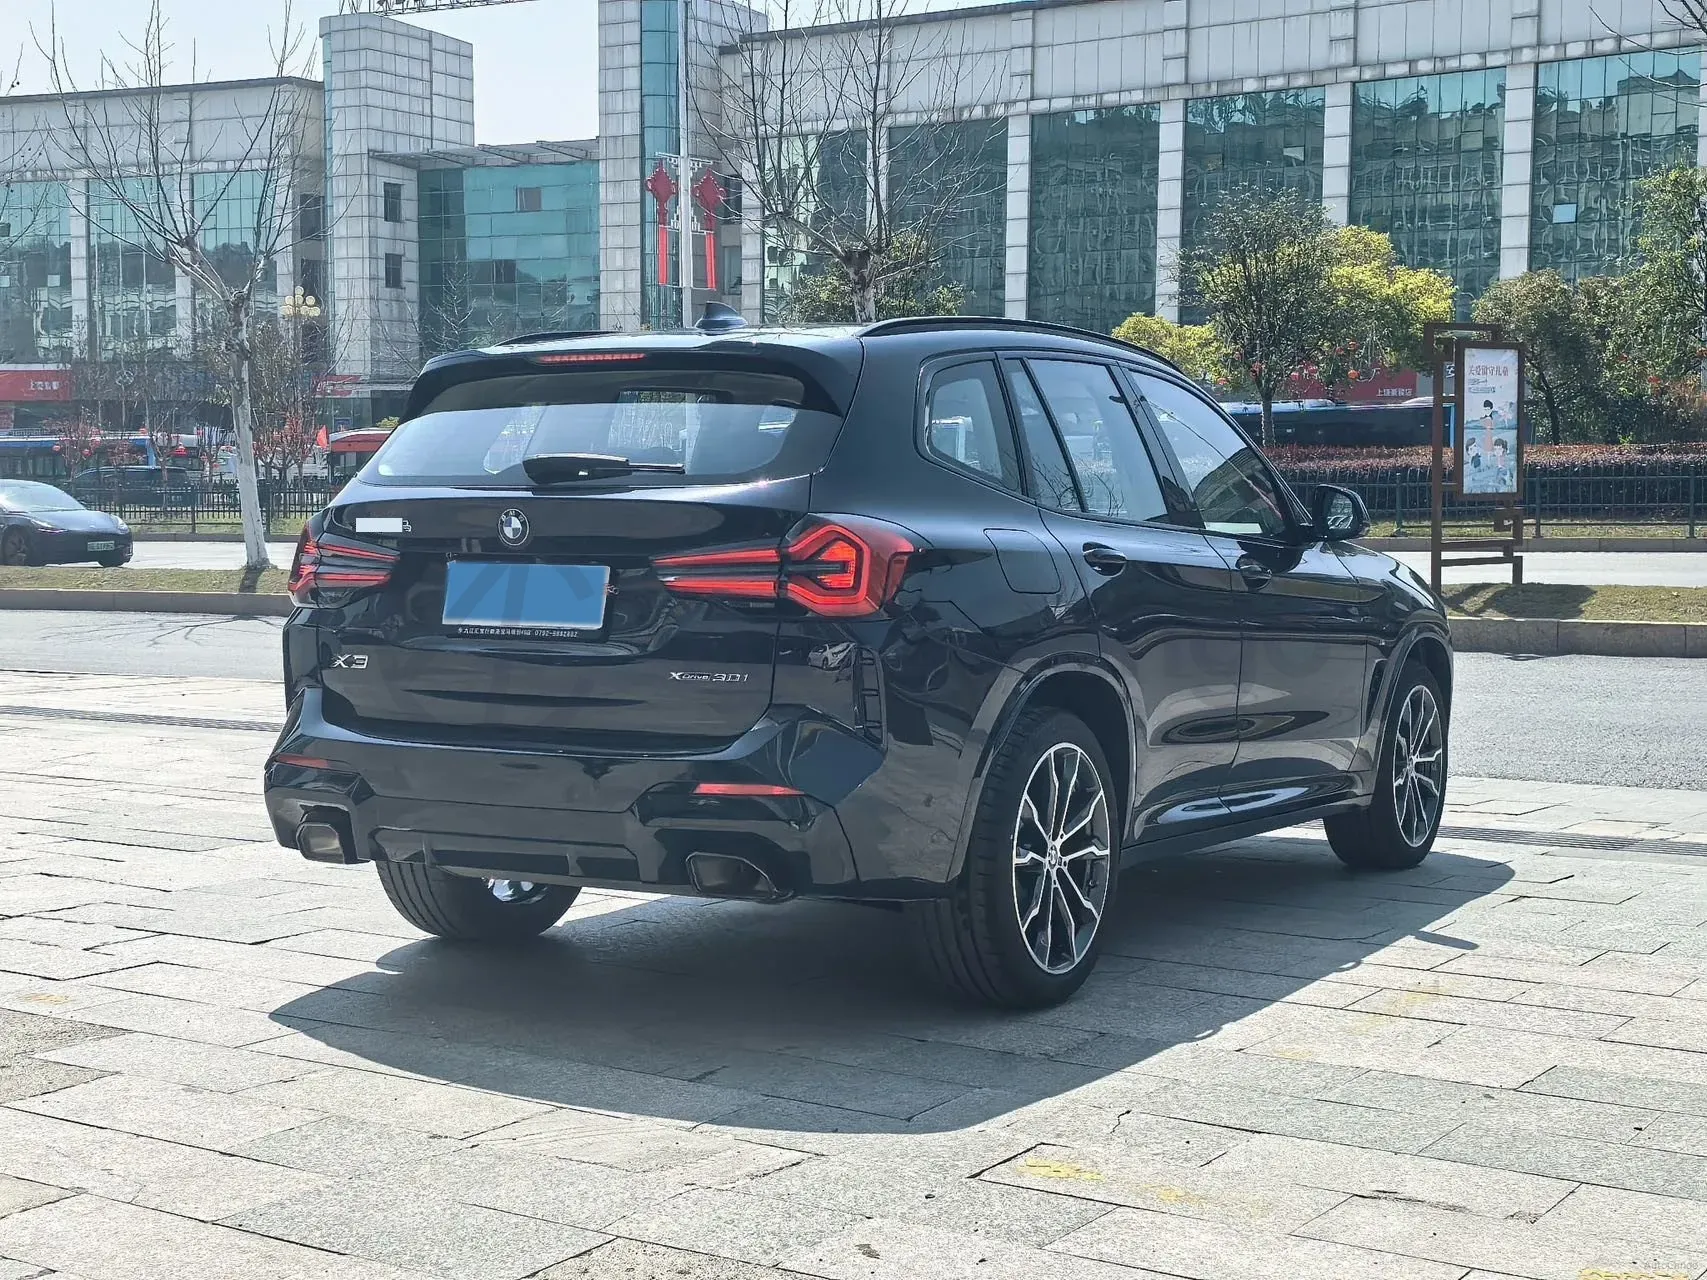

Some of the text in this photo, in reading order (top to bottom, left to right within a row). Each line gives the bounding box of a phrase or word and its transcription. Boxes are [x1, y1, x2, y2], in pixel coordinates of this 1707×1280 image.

[1468, 364, 1509, 376] 关爱留守儿童
[330, 653, 368, 669] X3
